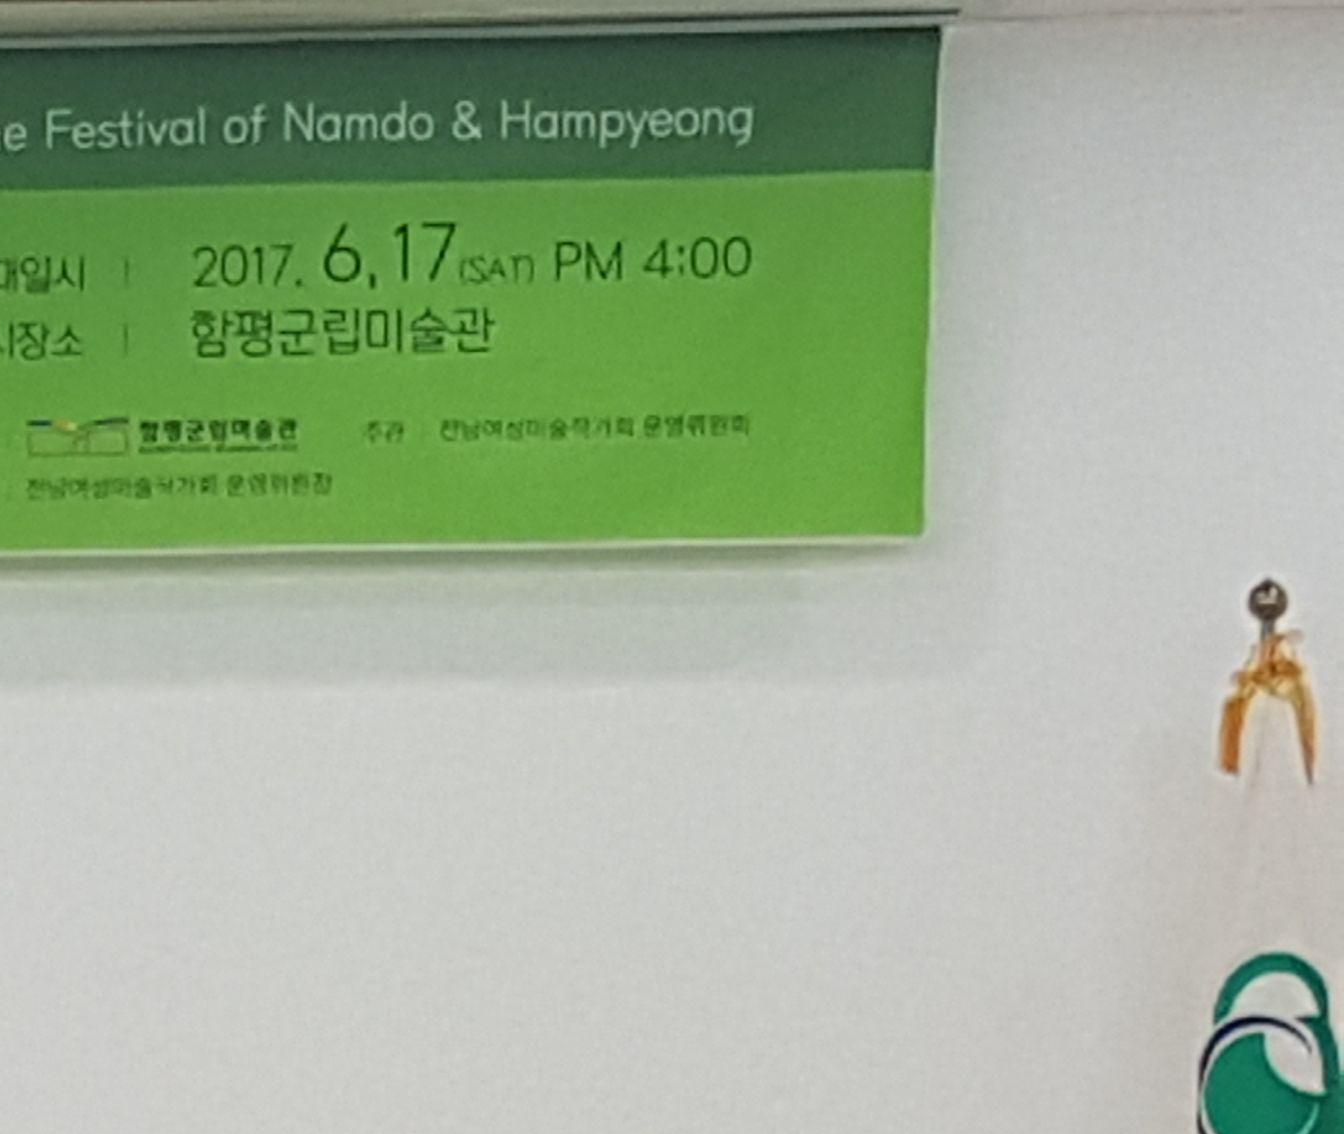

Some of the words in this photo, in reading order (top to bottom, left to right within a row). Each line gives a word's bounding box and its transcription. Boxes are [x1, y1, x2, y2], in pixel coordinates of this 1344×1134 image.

[47, 106, 207, 150] Festival
[224, 103, 267, 146] of
[285, 100, 435, 143] Namdo
[453, 101, 484, 142] &
[501, 99, 755, 149] Hampyeong
[555, 239, 626, 284] PM
[642, 234, 754, 281] 4:00
[191, 307, 497, 361] 함평군립미술관
